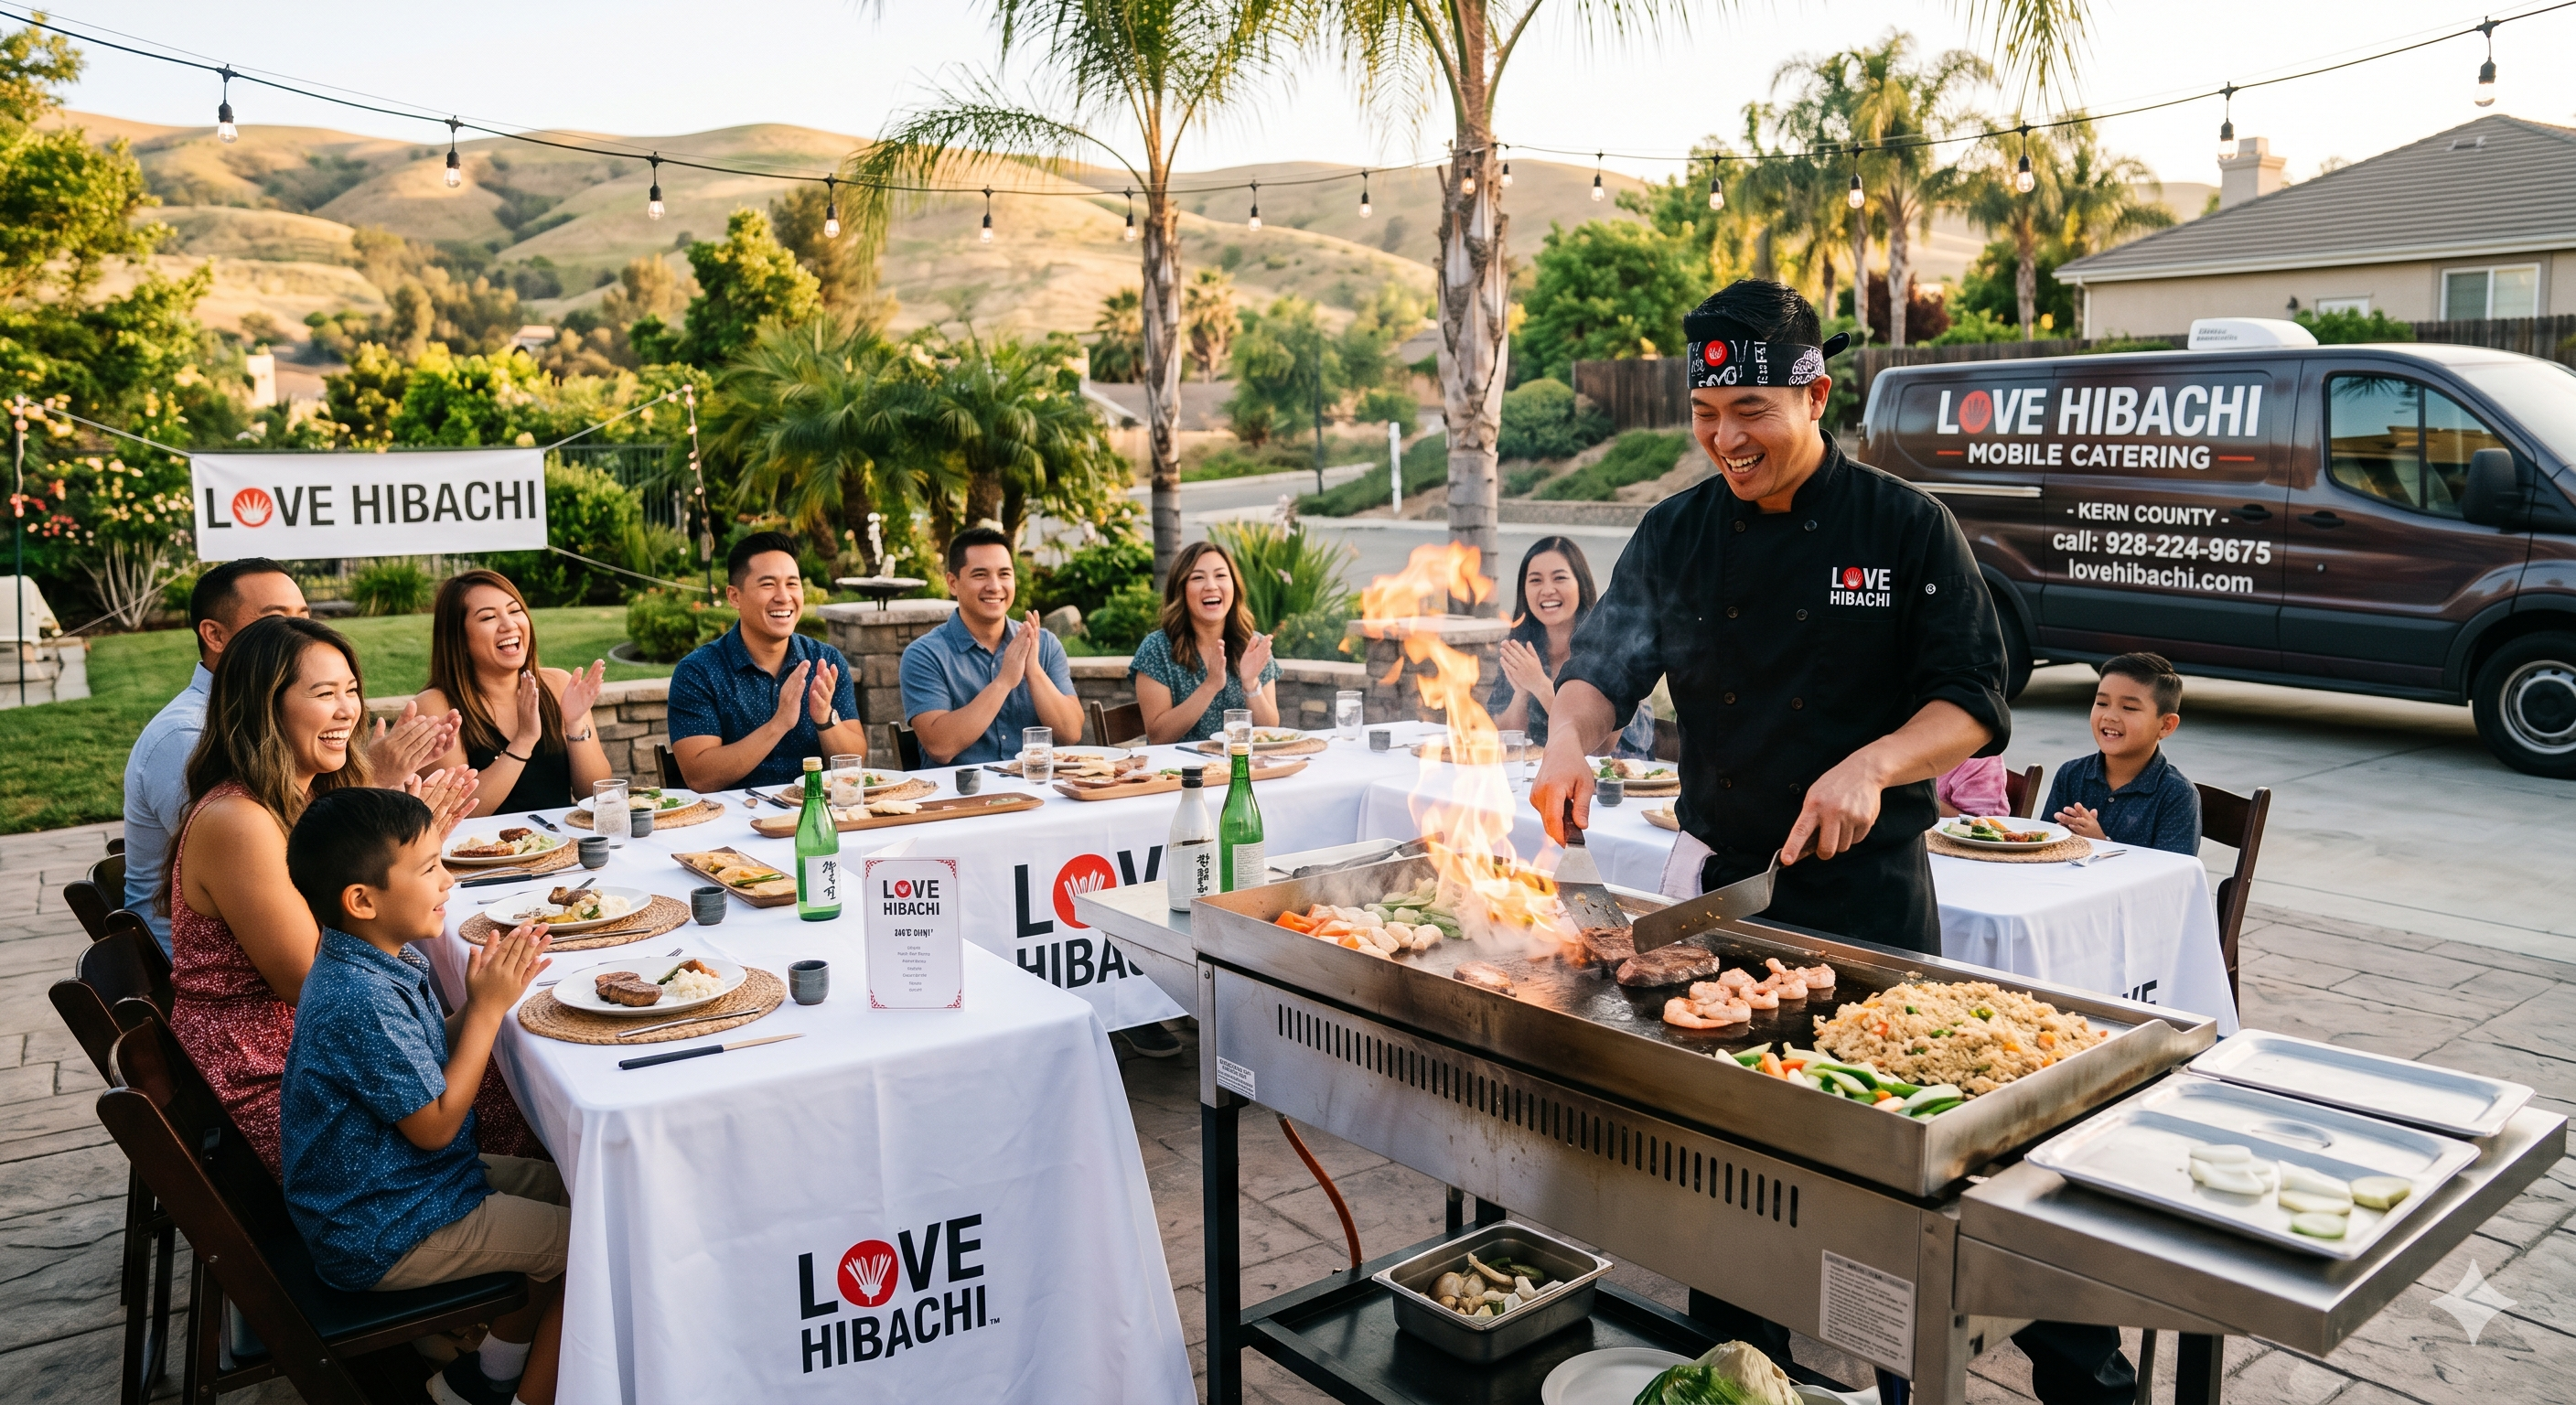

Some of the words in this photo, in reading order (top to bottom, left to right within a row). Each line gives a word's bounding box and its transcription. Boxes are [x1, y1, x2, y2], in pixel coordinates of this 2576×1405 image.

[1936, 387, 2048, 435] LOVE
[2057, 384, 2263, 437] HIBACHI
[1968, 442, 2064, 467] MOBILE
[2070, 444, 2211, 470] CATERING
[205, 485, 335, 529] LOVE
[352, 480, 537, 525] HIBACHI
[2077, 501, 2130, 521] KERN
[2133, 505, 2217, 527] COUNTY
[2052, 529, 2099, 552] call:
[2105, 531, 2272, 565] 928-224-9675
[1830, 566, 1891, 591] LOVE
[2067, 558, 2254, 594] lovehibachi.com
[1830, 590, 1891, 607] HIBACHI
[883, 879, 940, 899] LOVE
[883, 902, 940, 916] HIBACHI
[798, 1213, 984, 1321] LOVE
[801, 1284, 987, 1374] HIBACHI
